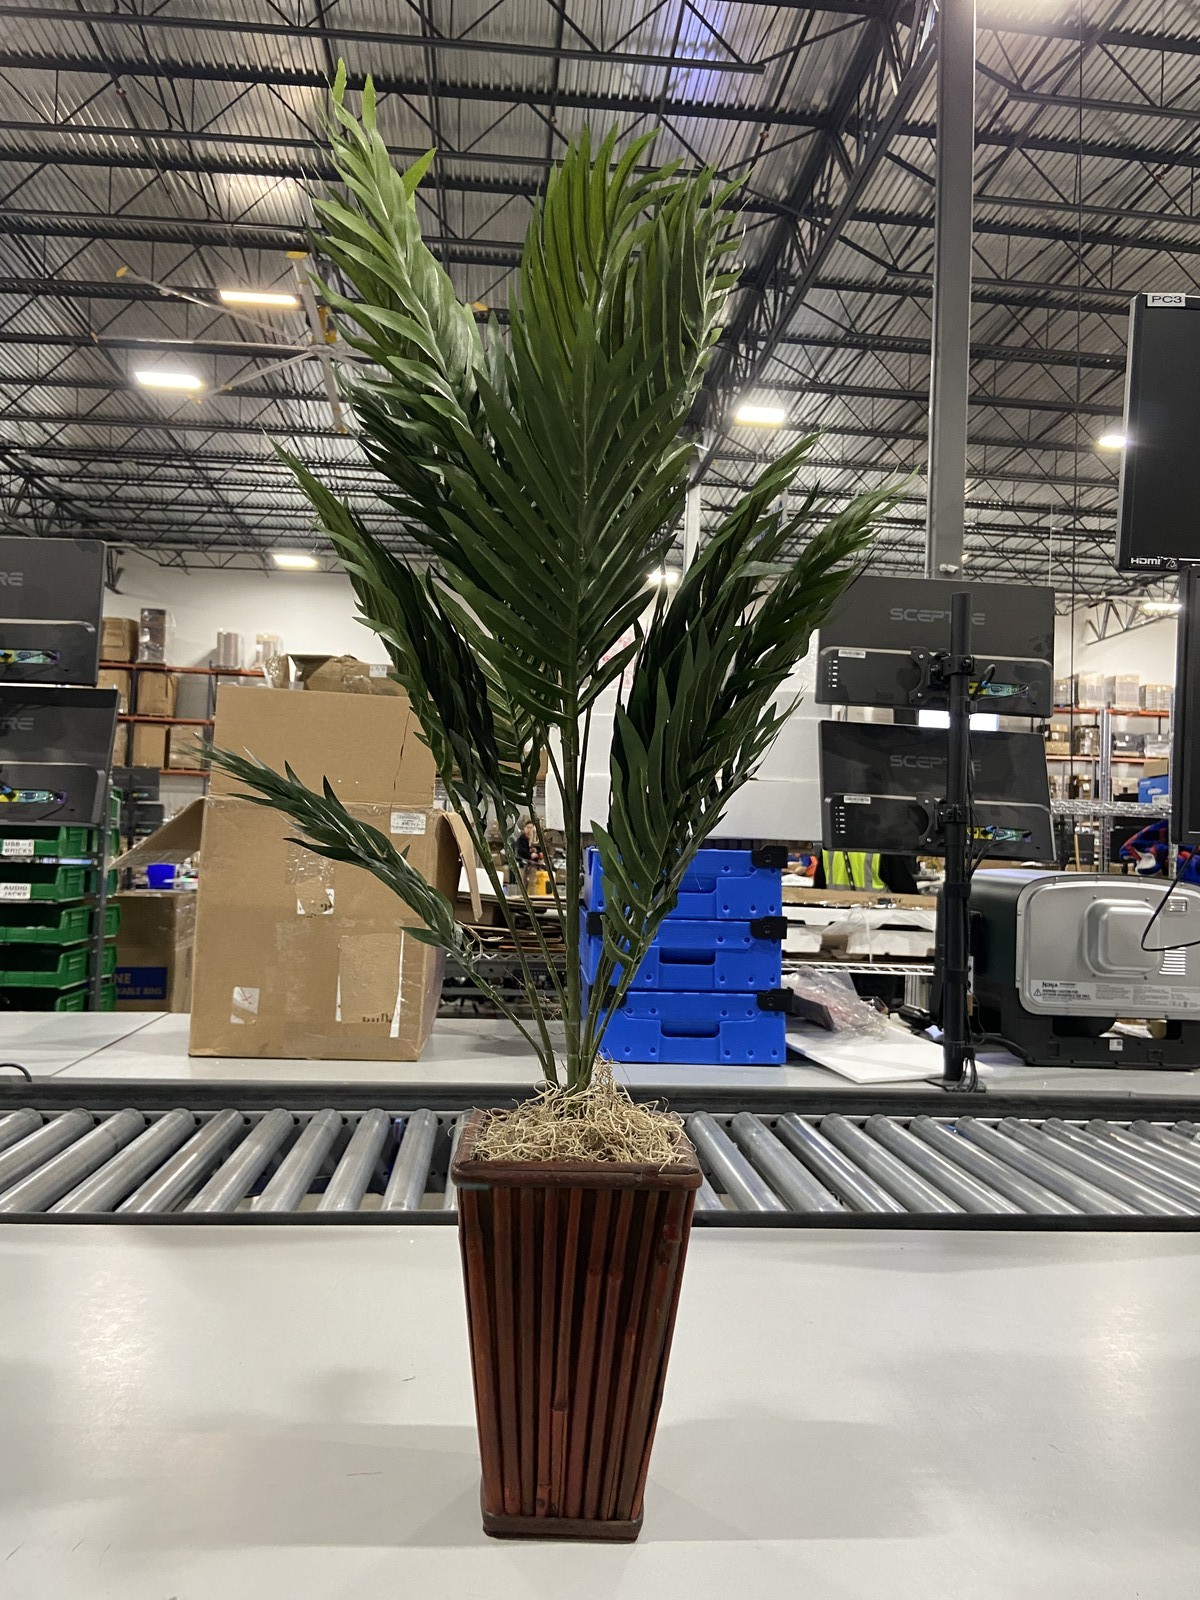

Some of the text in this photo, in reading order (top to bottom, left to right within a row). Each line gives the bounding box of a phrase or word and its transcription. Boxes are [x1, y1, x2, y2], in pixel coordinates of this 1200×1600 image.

[1152, 295, 1182, 303] PC3
[889, 607, 986, 626] SCEPTE
[889, 754, 982, 772] SCEPE
